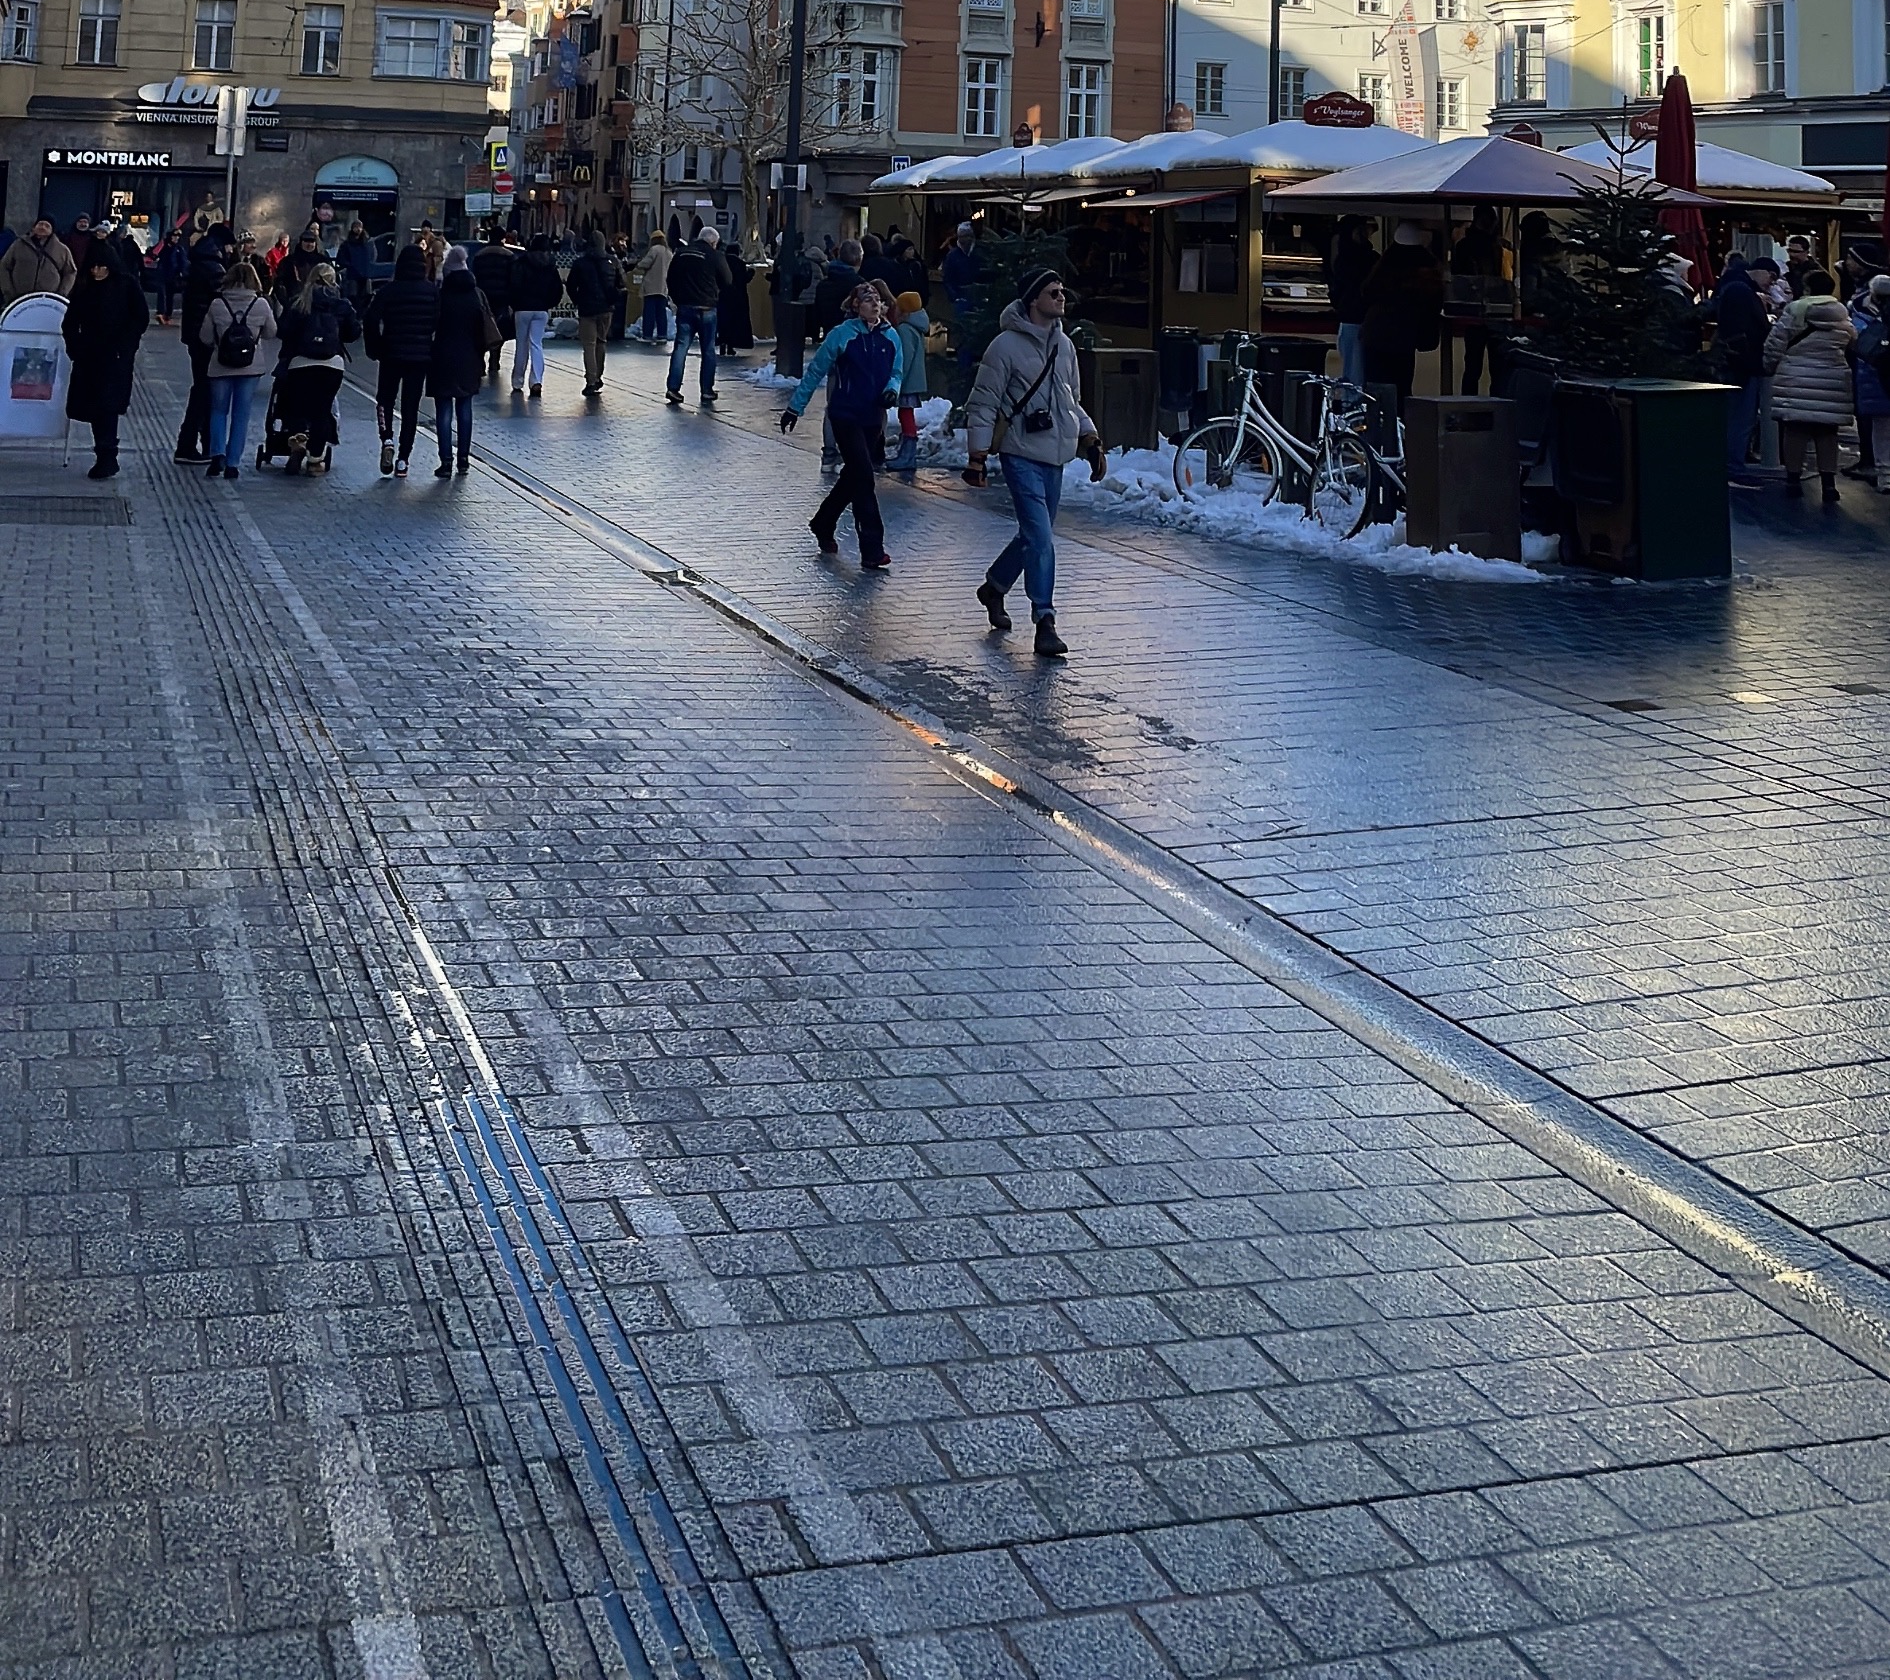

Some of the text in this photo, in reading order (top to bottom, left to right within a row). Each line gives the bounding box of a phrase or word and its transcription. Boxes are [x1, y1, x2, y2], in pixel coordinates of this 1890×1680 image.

[1399, 38, 1415, 99] WELCOME
[136, 112, 179, 124] VIENNA
[179, 114, 218, 125] INSURA
[67, 151, 170, 166] MONTBLANC
